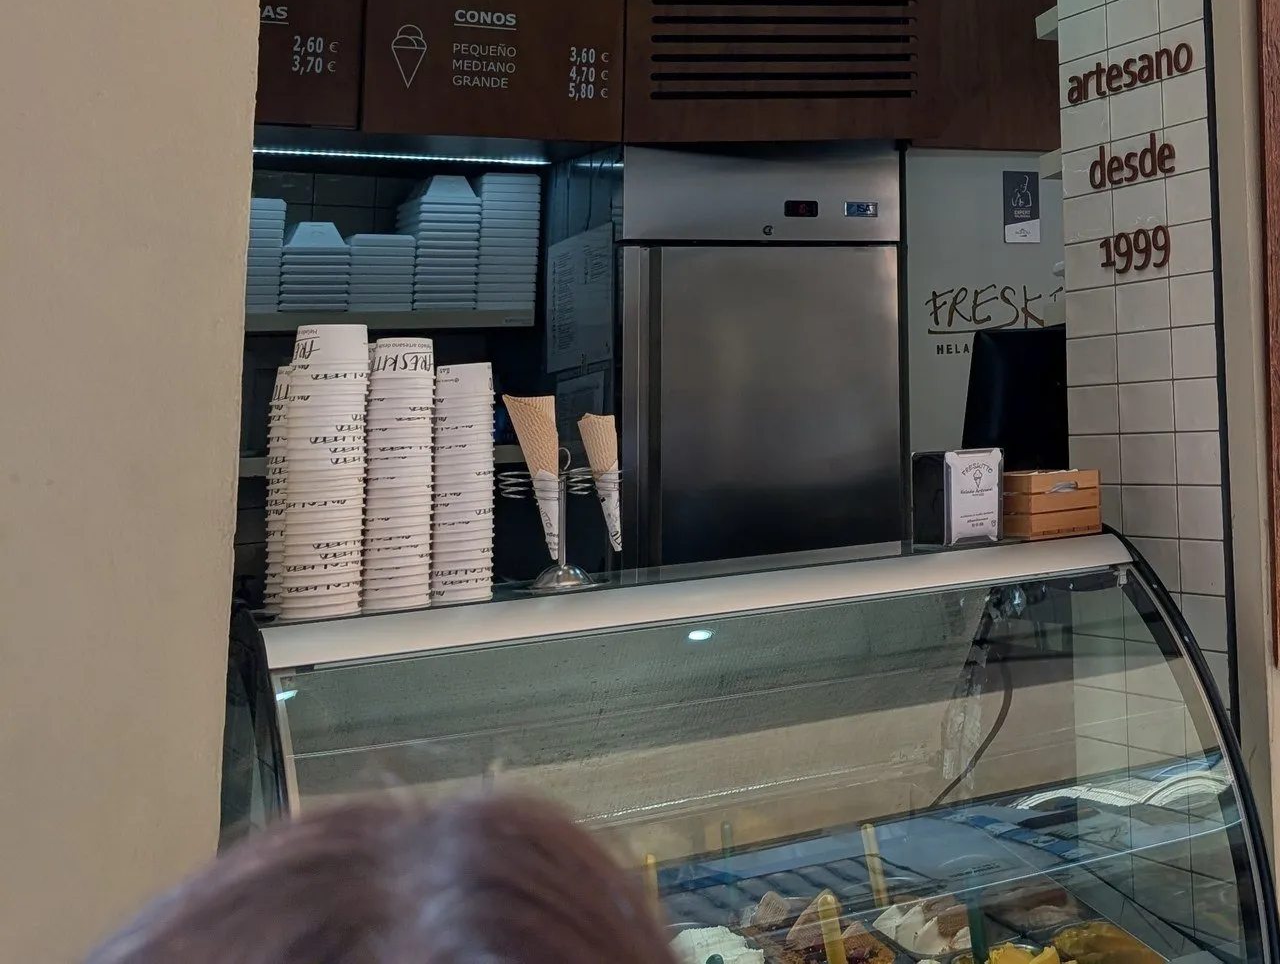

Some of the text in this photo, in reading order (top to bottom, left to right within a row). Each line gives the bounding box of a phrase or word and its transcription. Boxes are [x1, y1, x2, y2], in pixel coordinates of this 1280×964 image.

[261, 6, 288, 19] AS
[454, 10, 517, 26] CONOS
[293, 36, 323, 54] 2,60
[453, 43, 517, 57] PEQUEÑO
[570, 48, 596, 65] 3,60
[292, 57, 323, 74] 3,70
[452, 60, 516, 73] MEDIANO
[1068, 42, 1194, 104] artesano
[452, 75, 509, 89] GRANDE
[570, 66, 596, 83] 4,70
[569, 83, 595, 100] 5,80
[1089, 132, 1176, 189] desde
[1100, 225, 1171, 274] 1999
[925, 284, 1064, 329] FRESK
[936, 345, 970, 355] HELA
[372, 353, 434, 372] FRESKIT
